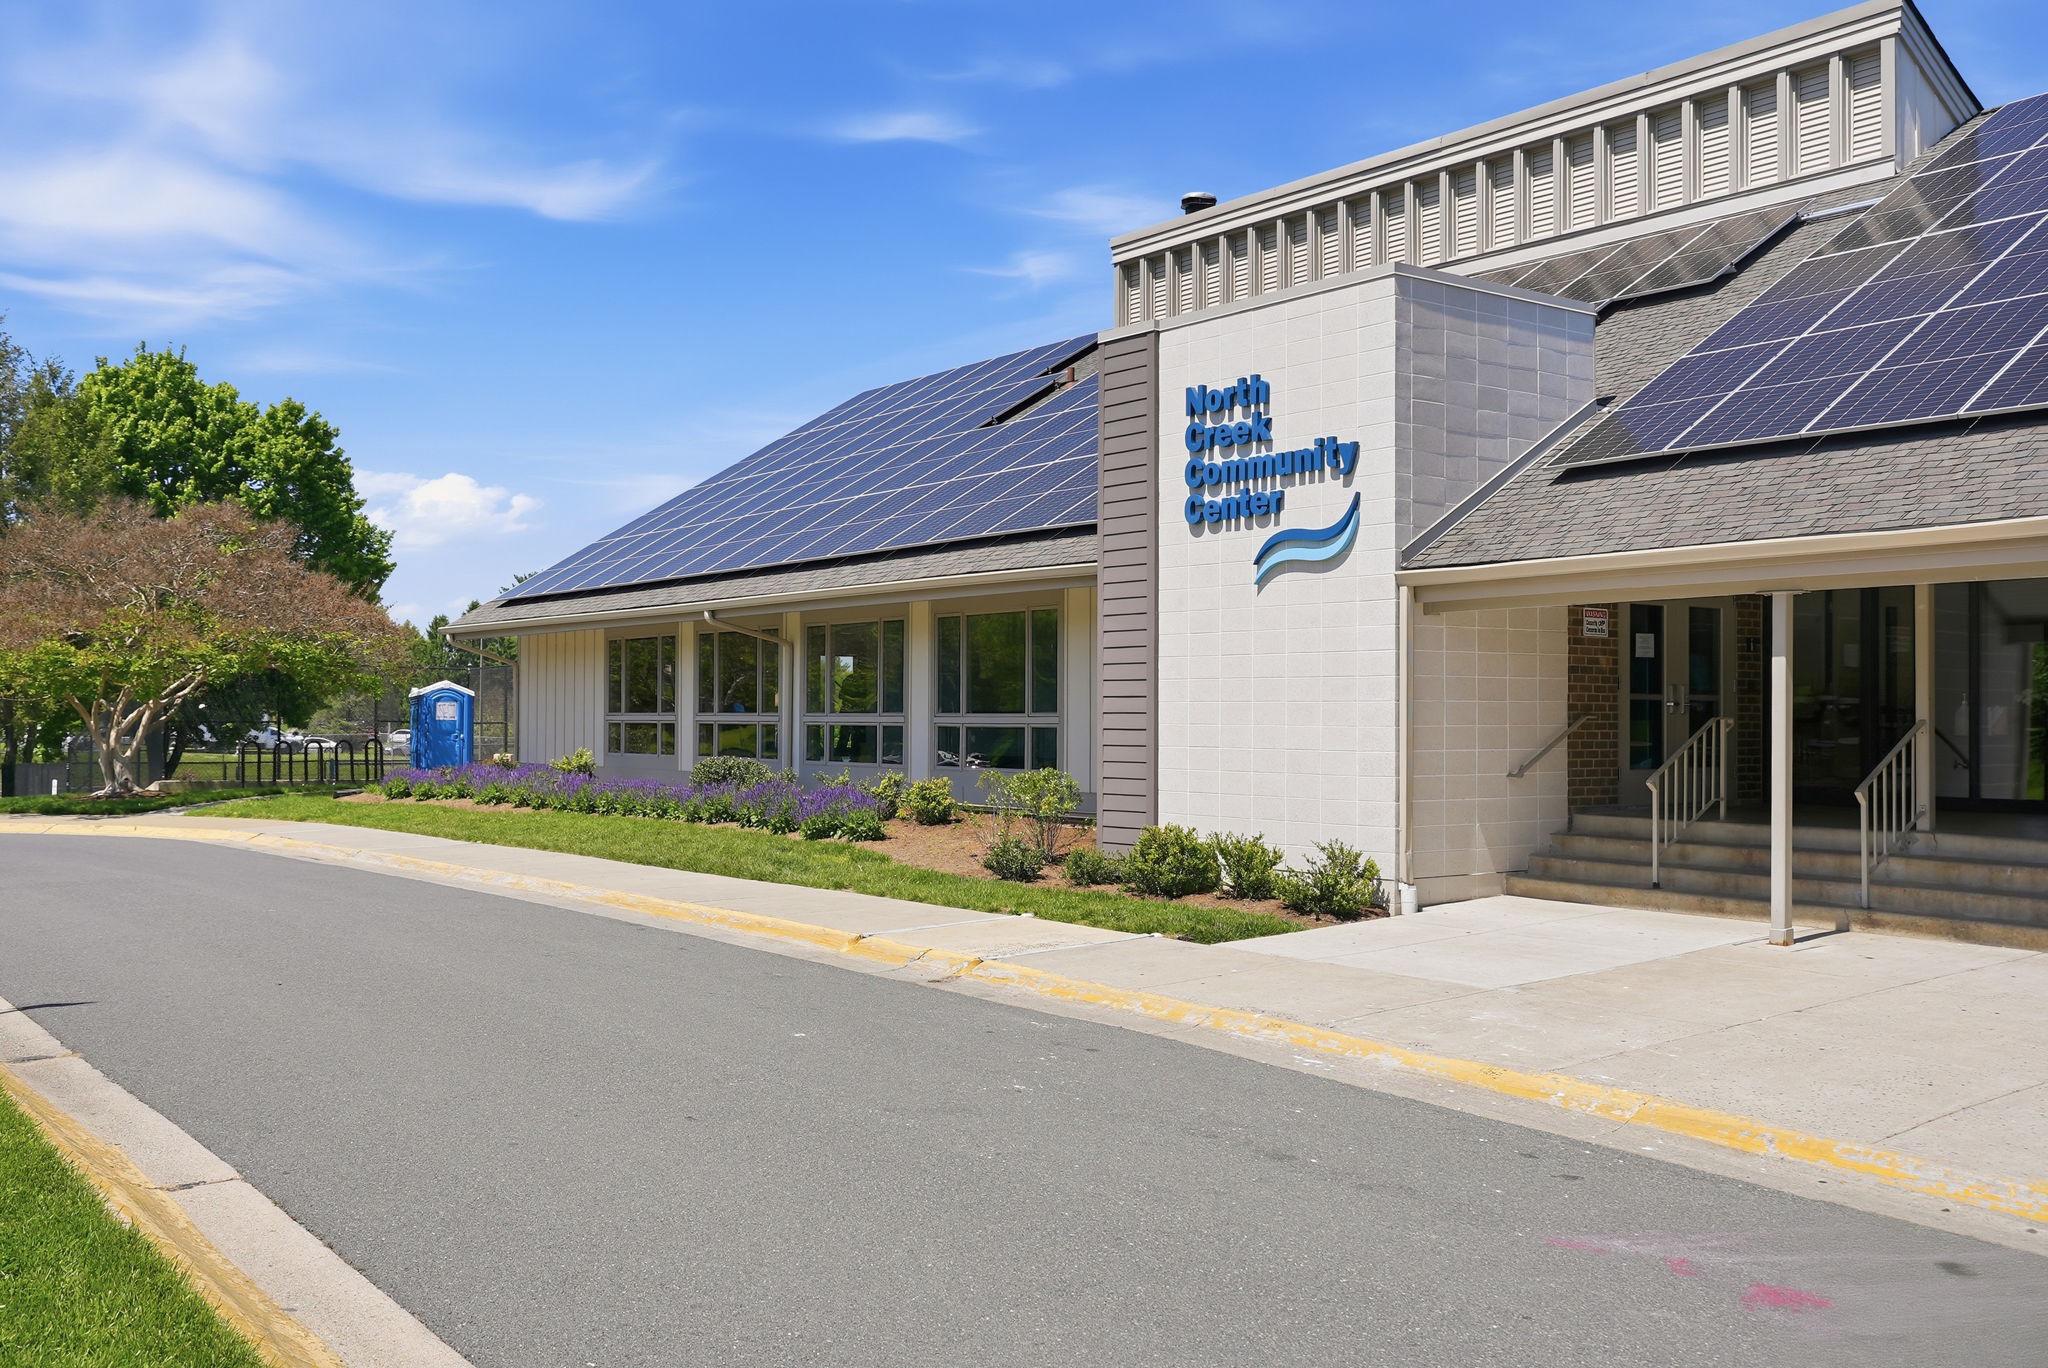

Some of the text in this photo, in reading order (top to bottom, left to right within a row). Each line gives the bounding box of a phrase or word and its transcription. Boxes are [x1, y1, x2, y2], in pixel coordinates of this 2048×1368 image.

[1186, 374, 1270, 416] North
[1185, 411, 1272, 453] Creek
[1185, 436, 1360, 488] Community
[1185, 488, 1284, 525] Center
